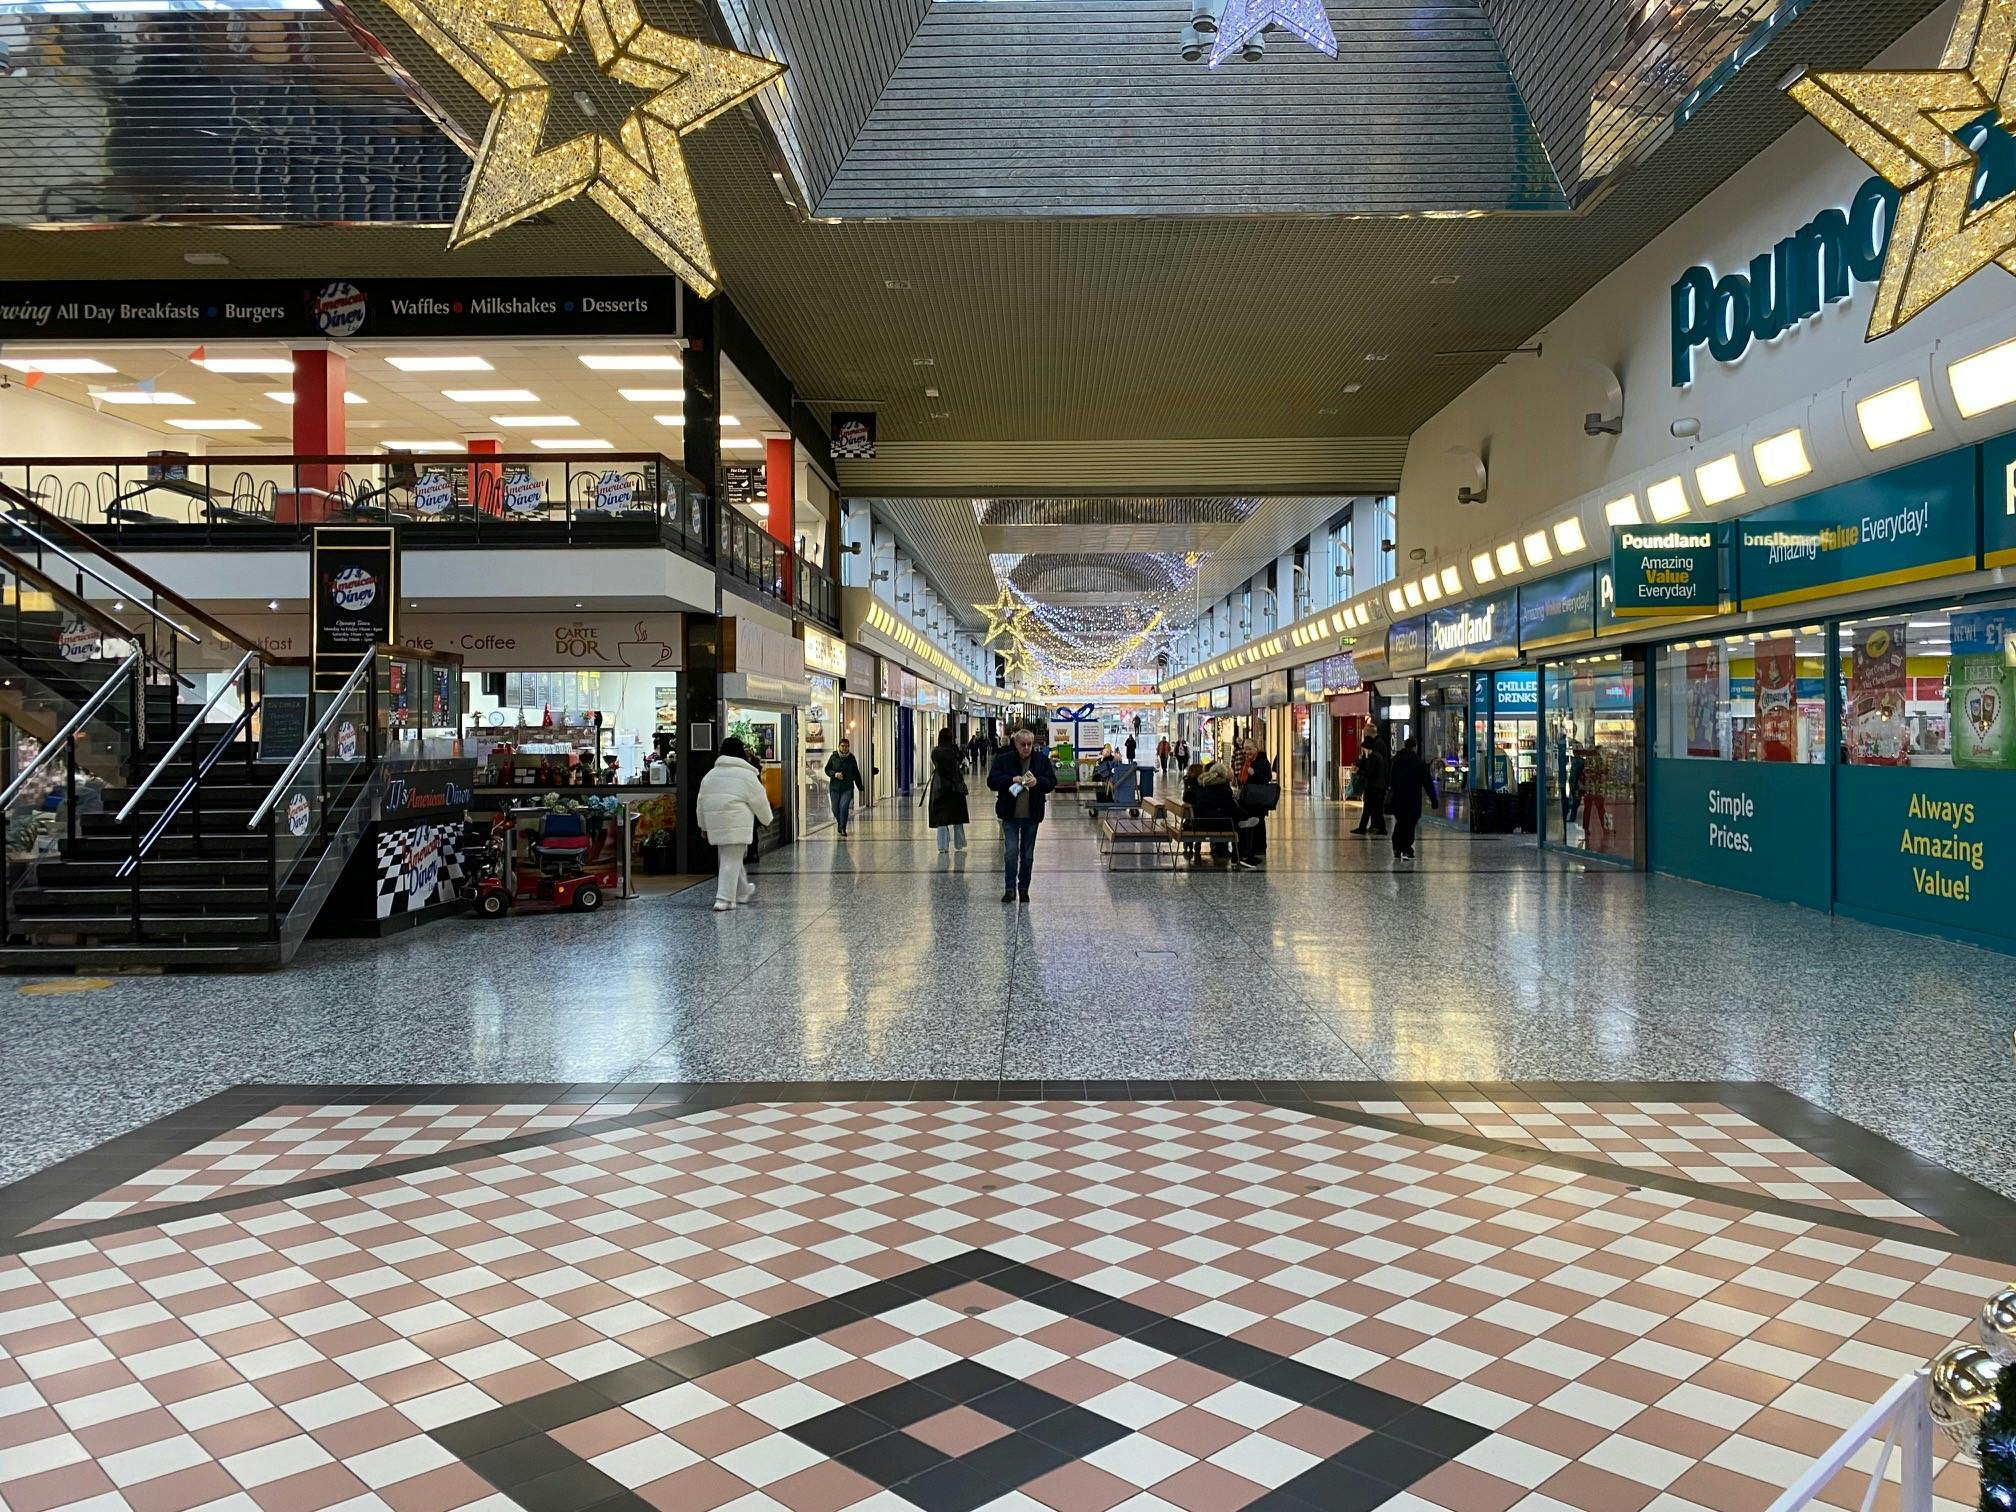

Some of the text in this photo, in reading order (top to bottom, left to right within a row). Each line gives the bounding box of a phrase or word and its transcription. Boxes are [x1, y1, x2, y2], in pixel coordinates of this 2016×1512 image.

[57, 303, 79, 320] All
[84, 303, 116, 324] Day
[120, 302, 200, 320] Breakfasts
[225, 303, 286, 323] Burgers
[391, 297, 648, 315] Waffles Milkshakes Desserts
[598, 470, 622, 485] JJ's
[504, 480, 546, 496] American
[593, 480, 636, 495] American
[414, 493, 450, 509] Diner
[505, 492, 541, 509] Diner
[595, 492, 631, 508] Diner
[1622, 533, 1711, 549] Poundland
[1769, 501, 1928, 565] Amazing Value Everyday!
[1641, 555, 1694, 571] Amazing
[1646, 569, 1690, 584] Value
[332, 588, 374, 606] Diner
[1638, 583, 1696, 599] Everyday!
[1562, 590, 1590, 614] Everyday!
[555, 626, 600, 643] CARTE
[1432, 605, 1491, 652] Poundland
[1953, 624, 1978, 643] NEW!
[400, 636, 434, 650] ake
[460, 634, 515, 650] Coffee
[1497, 681, 1537, 692] CHILLED
[1498, 692, 1538, 703] DRINKS
[386, 780, 471, 810] JJ's American Diner
[1708, 788, 1754, 822] Simple
[1908, 793, 1975, 830] Always
[1709, 823, 1753, 852] Prices.
[1900, 828, 1984, 871] Amazing
[407, 861, 437, 896] Diner
[1912, 866, 1970, 902] Value!
